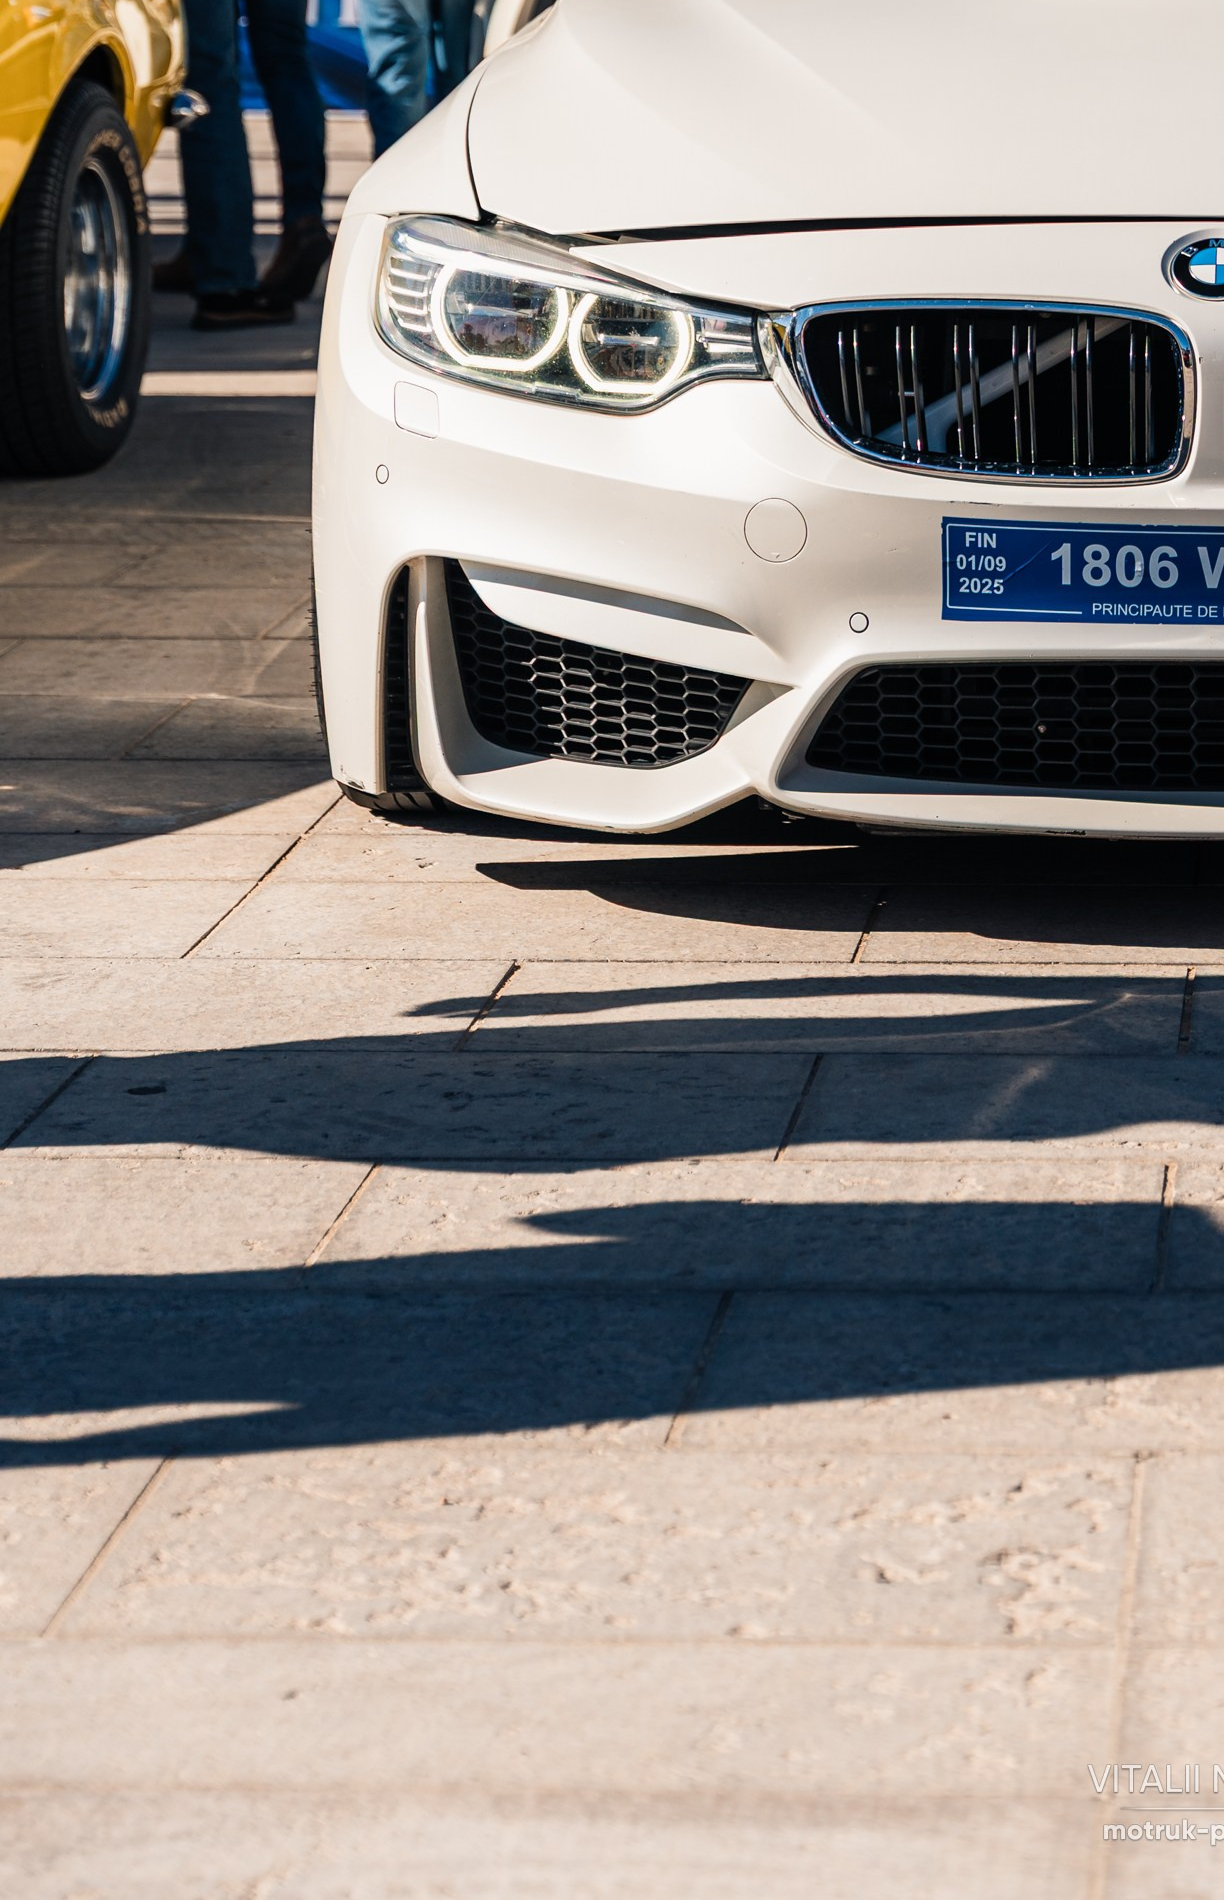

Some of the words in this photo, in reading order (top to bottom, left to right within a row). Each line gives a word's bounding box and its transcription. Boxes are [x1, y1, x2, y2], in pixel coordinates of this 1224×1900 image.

[964, 531, 997, 549] FIN
[956, 554, 1007, 572] 01/09
[1051, 542, 1179, 588] 1806
[959, 577, 1004, 594] 2025
[1092, 602, 1193, 617] PRINCIPAUTE
[1197, 605, 1218, 618] DE
